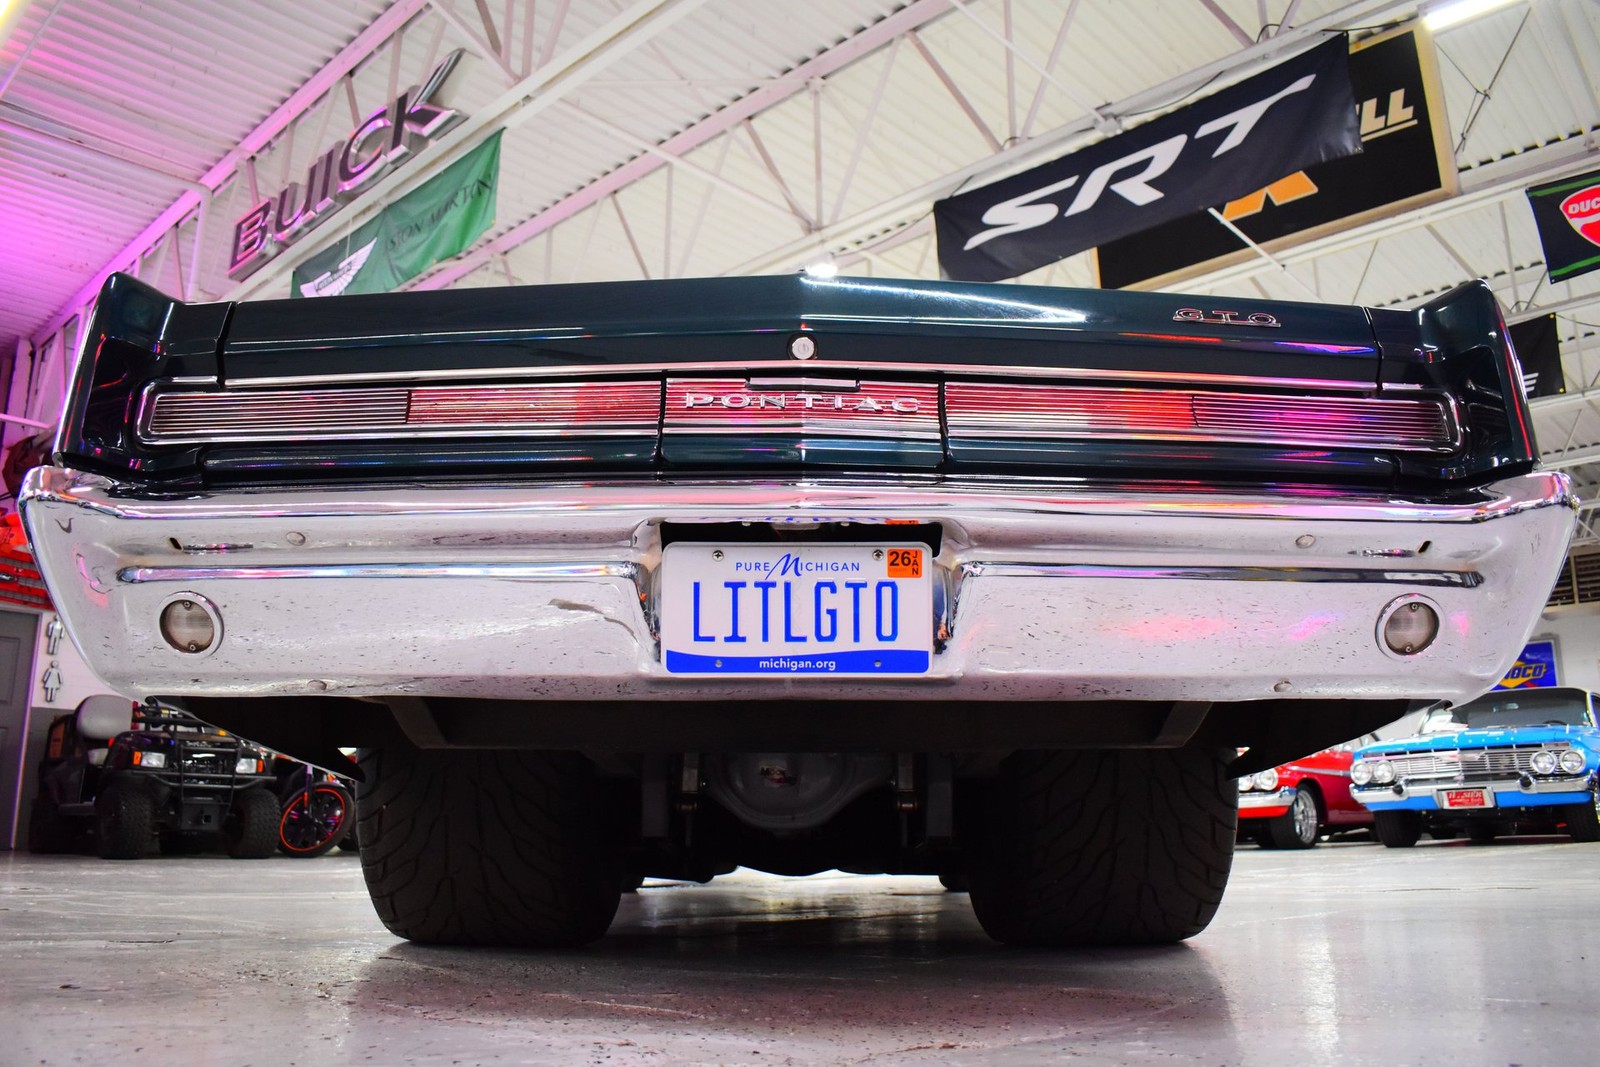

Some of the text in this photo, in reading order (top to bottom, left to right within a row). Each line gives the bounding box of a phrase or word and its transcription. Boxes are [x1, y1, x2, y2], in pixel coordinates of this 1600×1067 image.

[1355, 88, 1415, 136] LL
[228, 47, 467, 277] BUICK
[963, 73, 1317, 251] SRT
[1173, 307, 1281, 327] GTO
[685, 392, 921, 414] PONTIAC
[735, 553, 861, 580] PURE MICHIGAN
[889, 550, 912, 567] 26
[911, 550, 919, 576] JAN
[692, 580, 899, 643] LITLGTO
[758, 658, 837, 671] michigan.org
